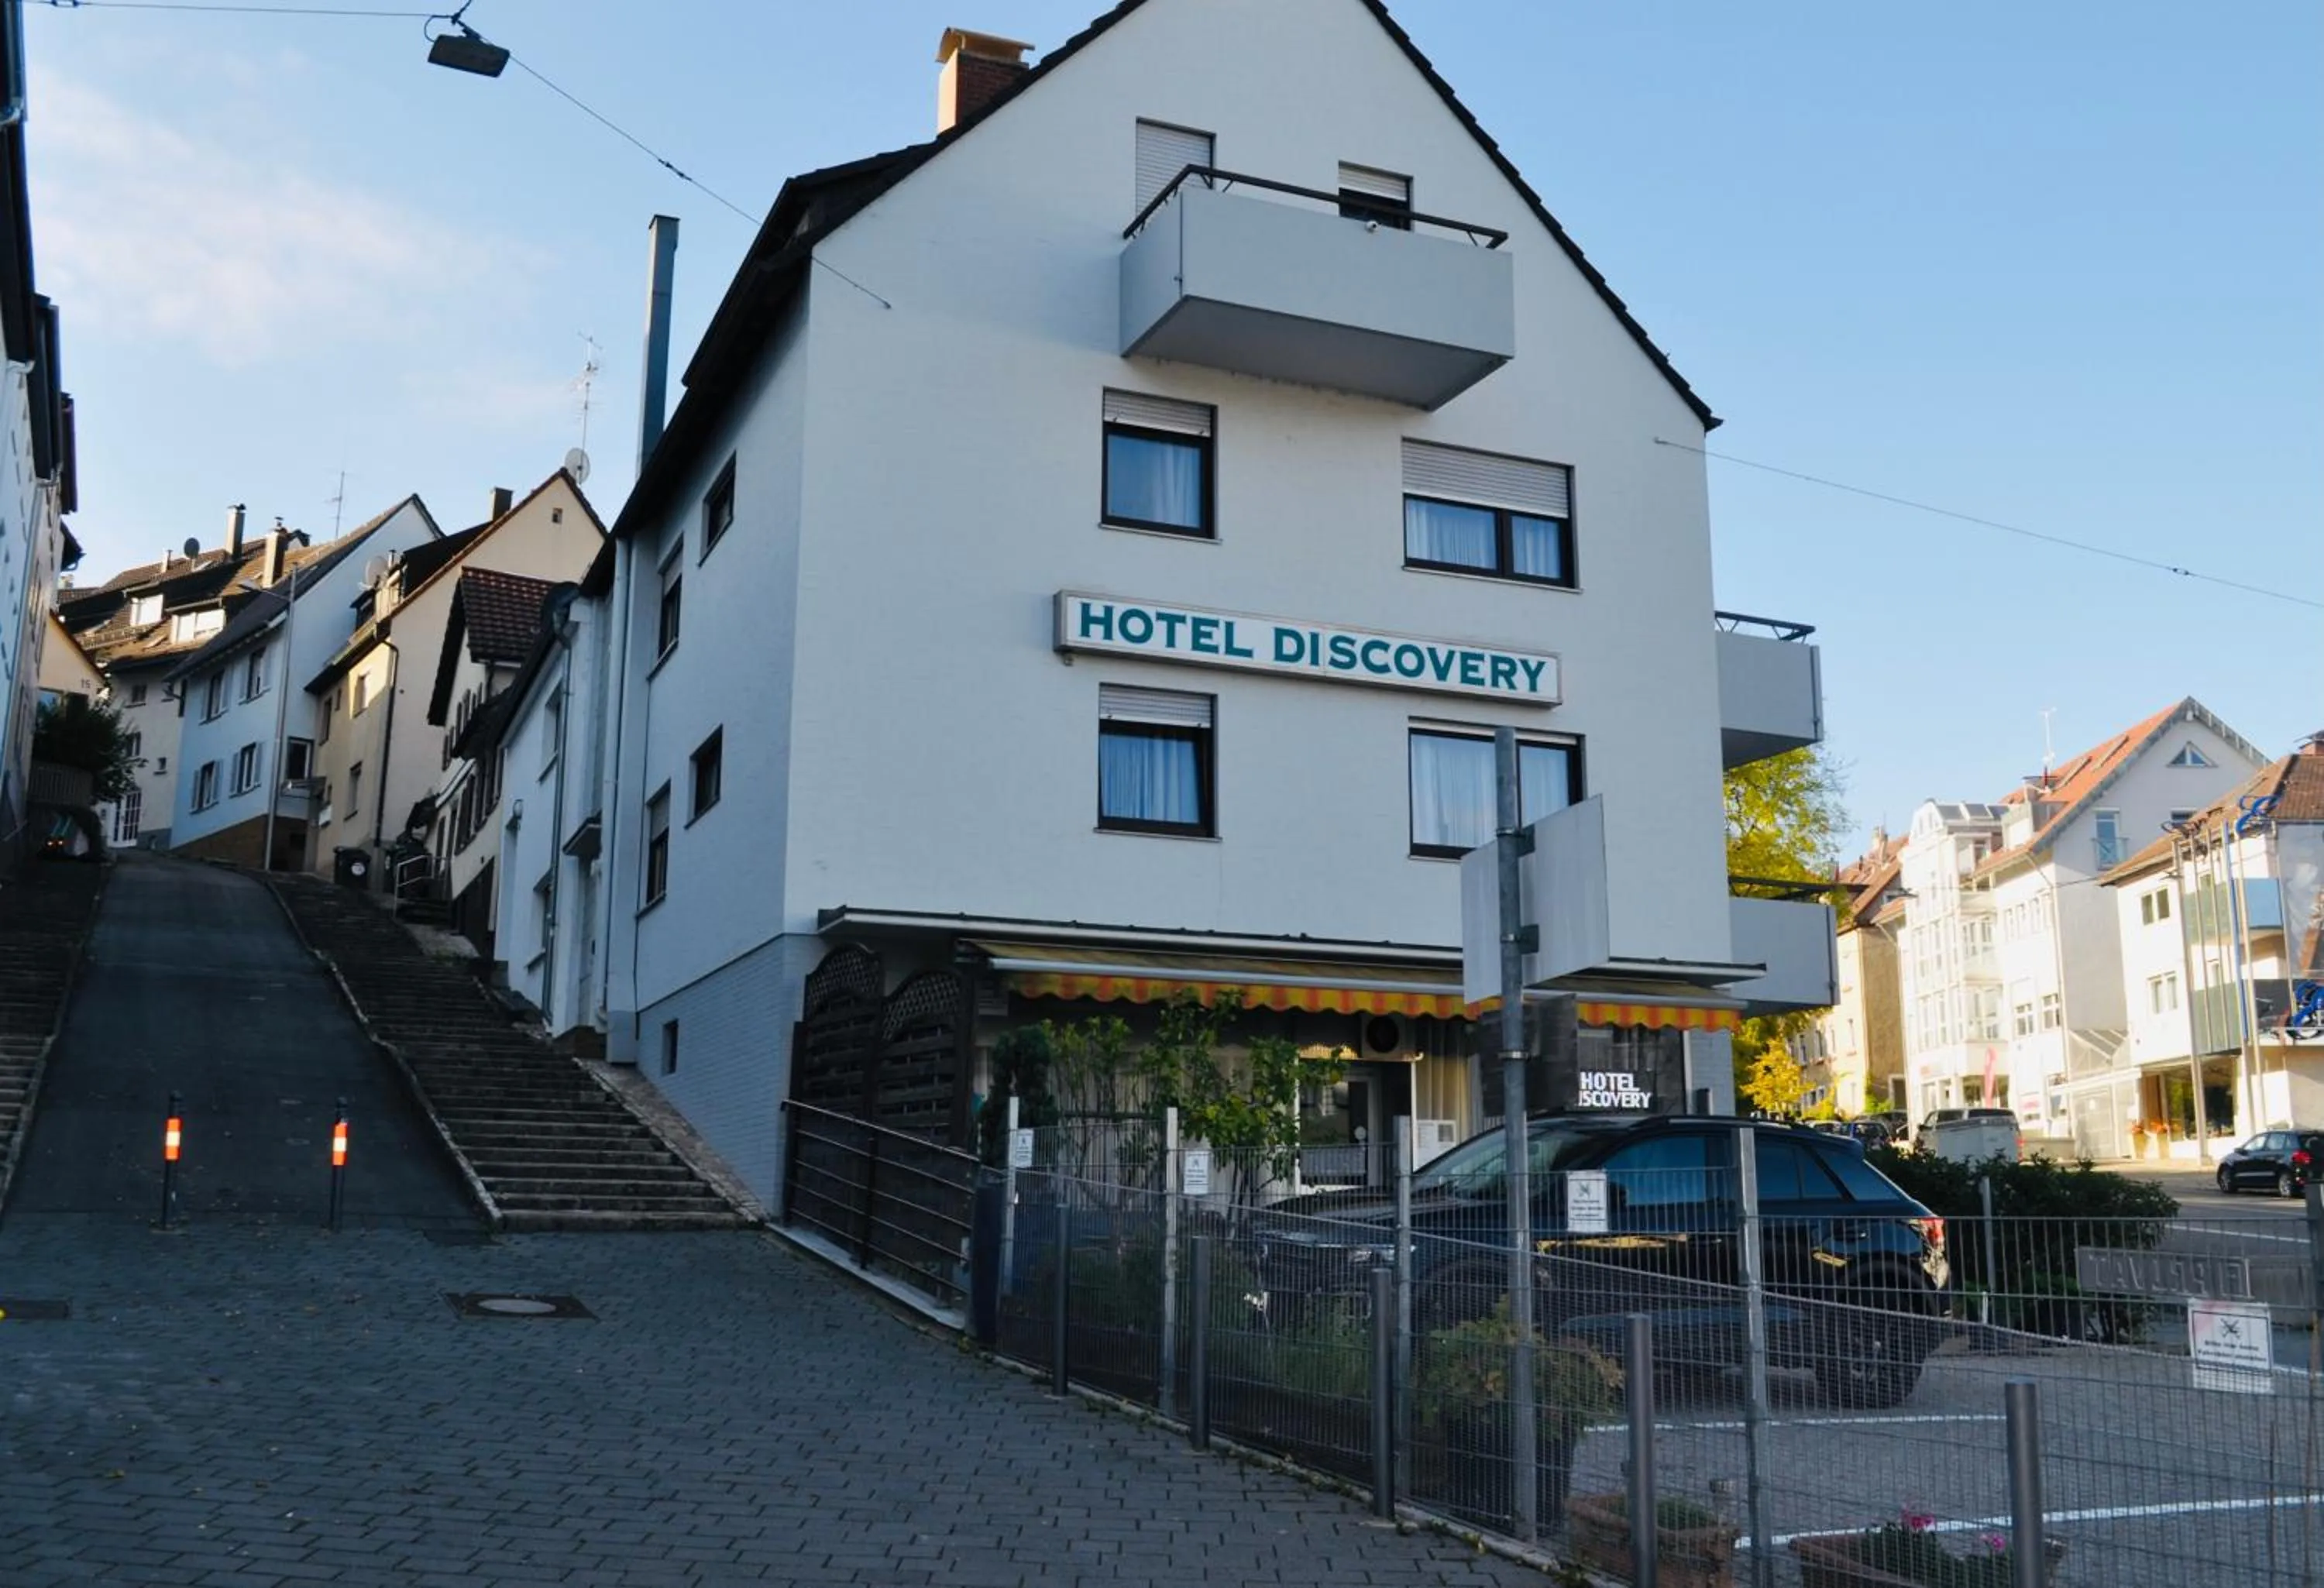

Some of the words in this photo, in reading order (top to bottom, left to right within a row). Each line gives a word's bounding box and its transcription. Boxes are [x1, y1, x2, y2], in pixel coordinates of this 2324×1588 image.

[1081, 602, 1253, 658] HOTEL
[1273, 626, 1547, 693] DISCOVERY
[1580, 1071, 1641, 1091] HOTEL
[1576, 1090, 1652, 1109] ISCOVERY
